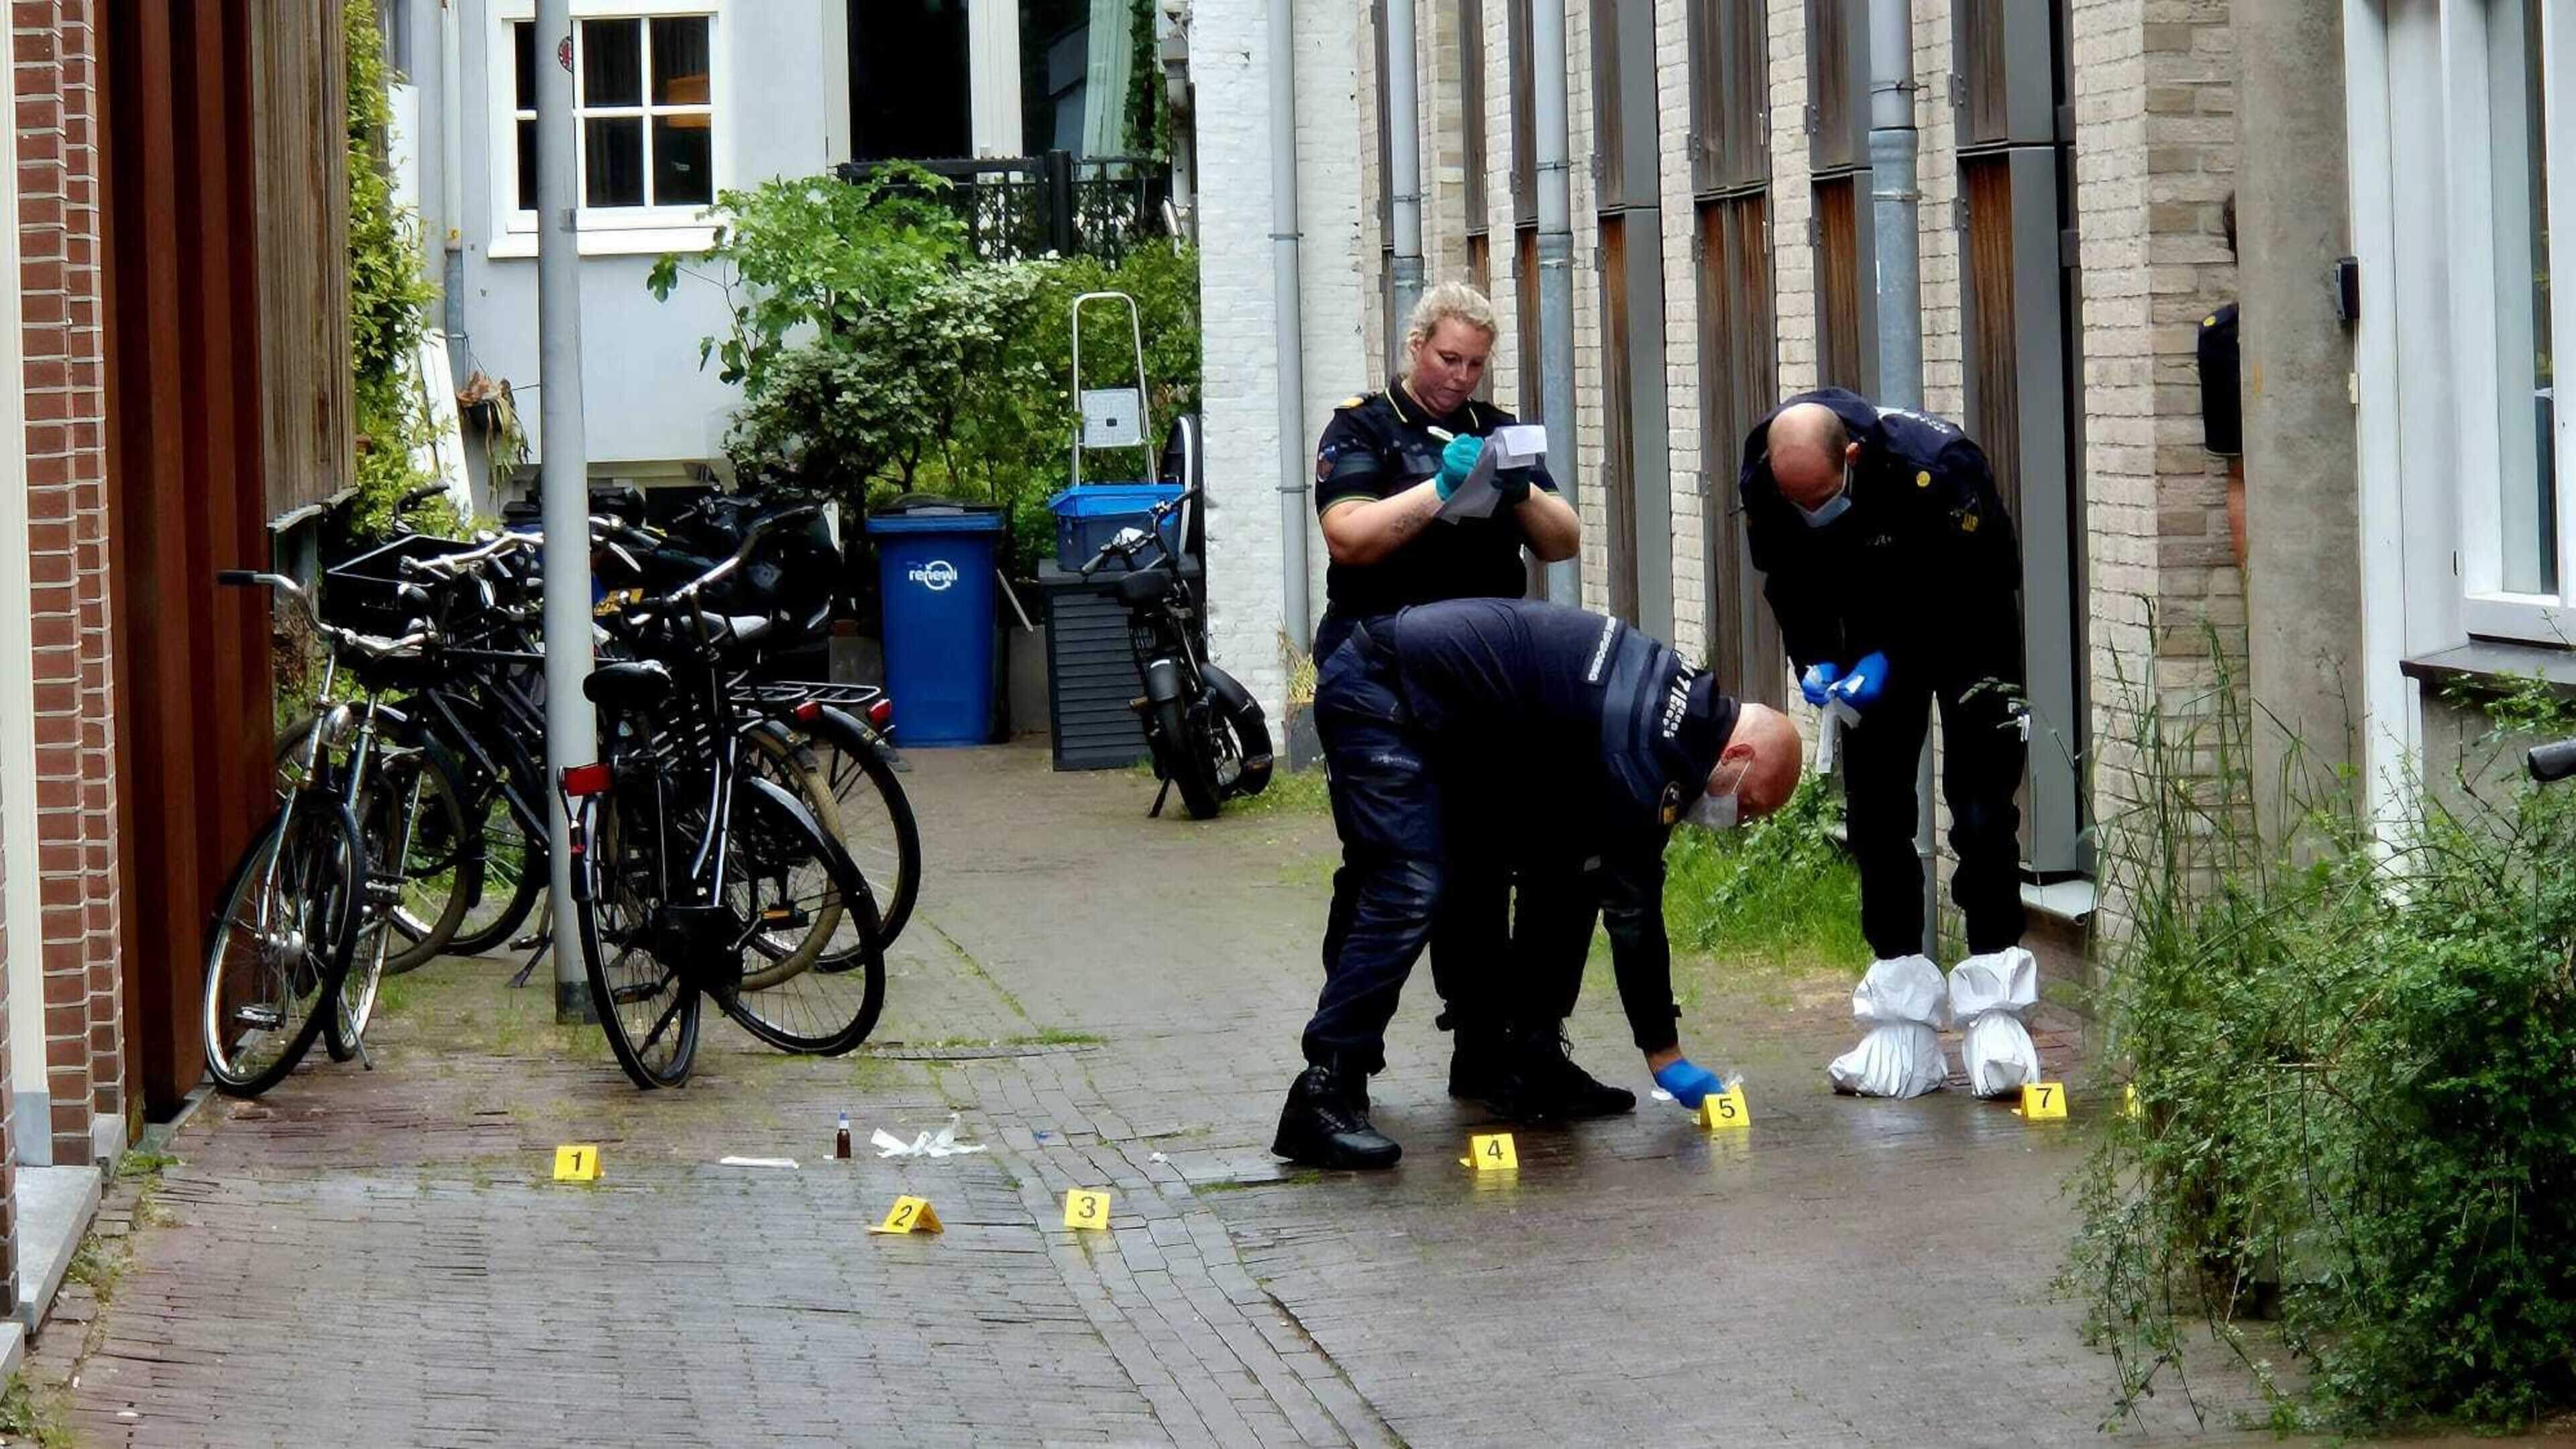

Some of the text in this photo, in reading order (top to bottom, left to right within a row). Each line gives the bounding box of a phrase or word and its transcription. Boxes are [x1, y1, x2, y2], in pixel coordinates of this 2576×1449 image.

[908, 566, 958, 581] renewi
[1719, 1097, 1736, 1119] 5
[2035, 1087, 2052, 1108] 7
[1487, 1139, 1504, 1160] 4
[571, 1151, 582, 1172] 1
[893, 1205, 913, 1227] 2
[1079, 1196, 1096, 1218] 3
